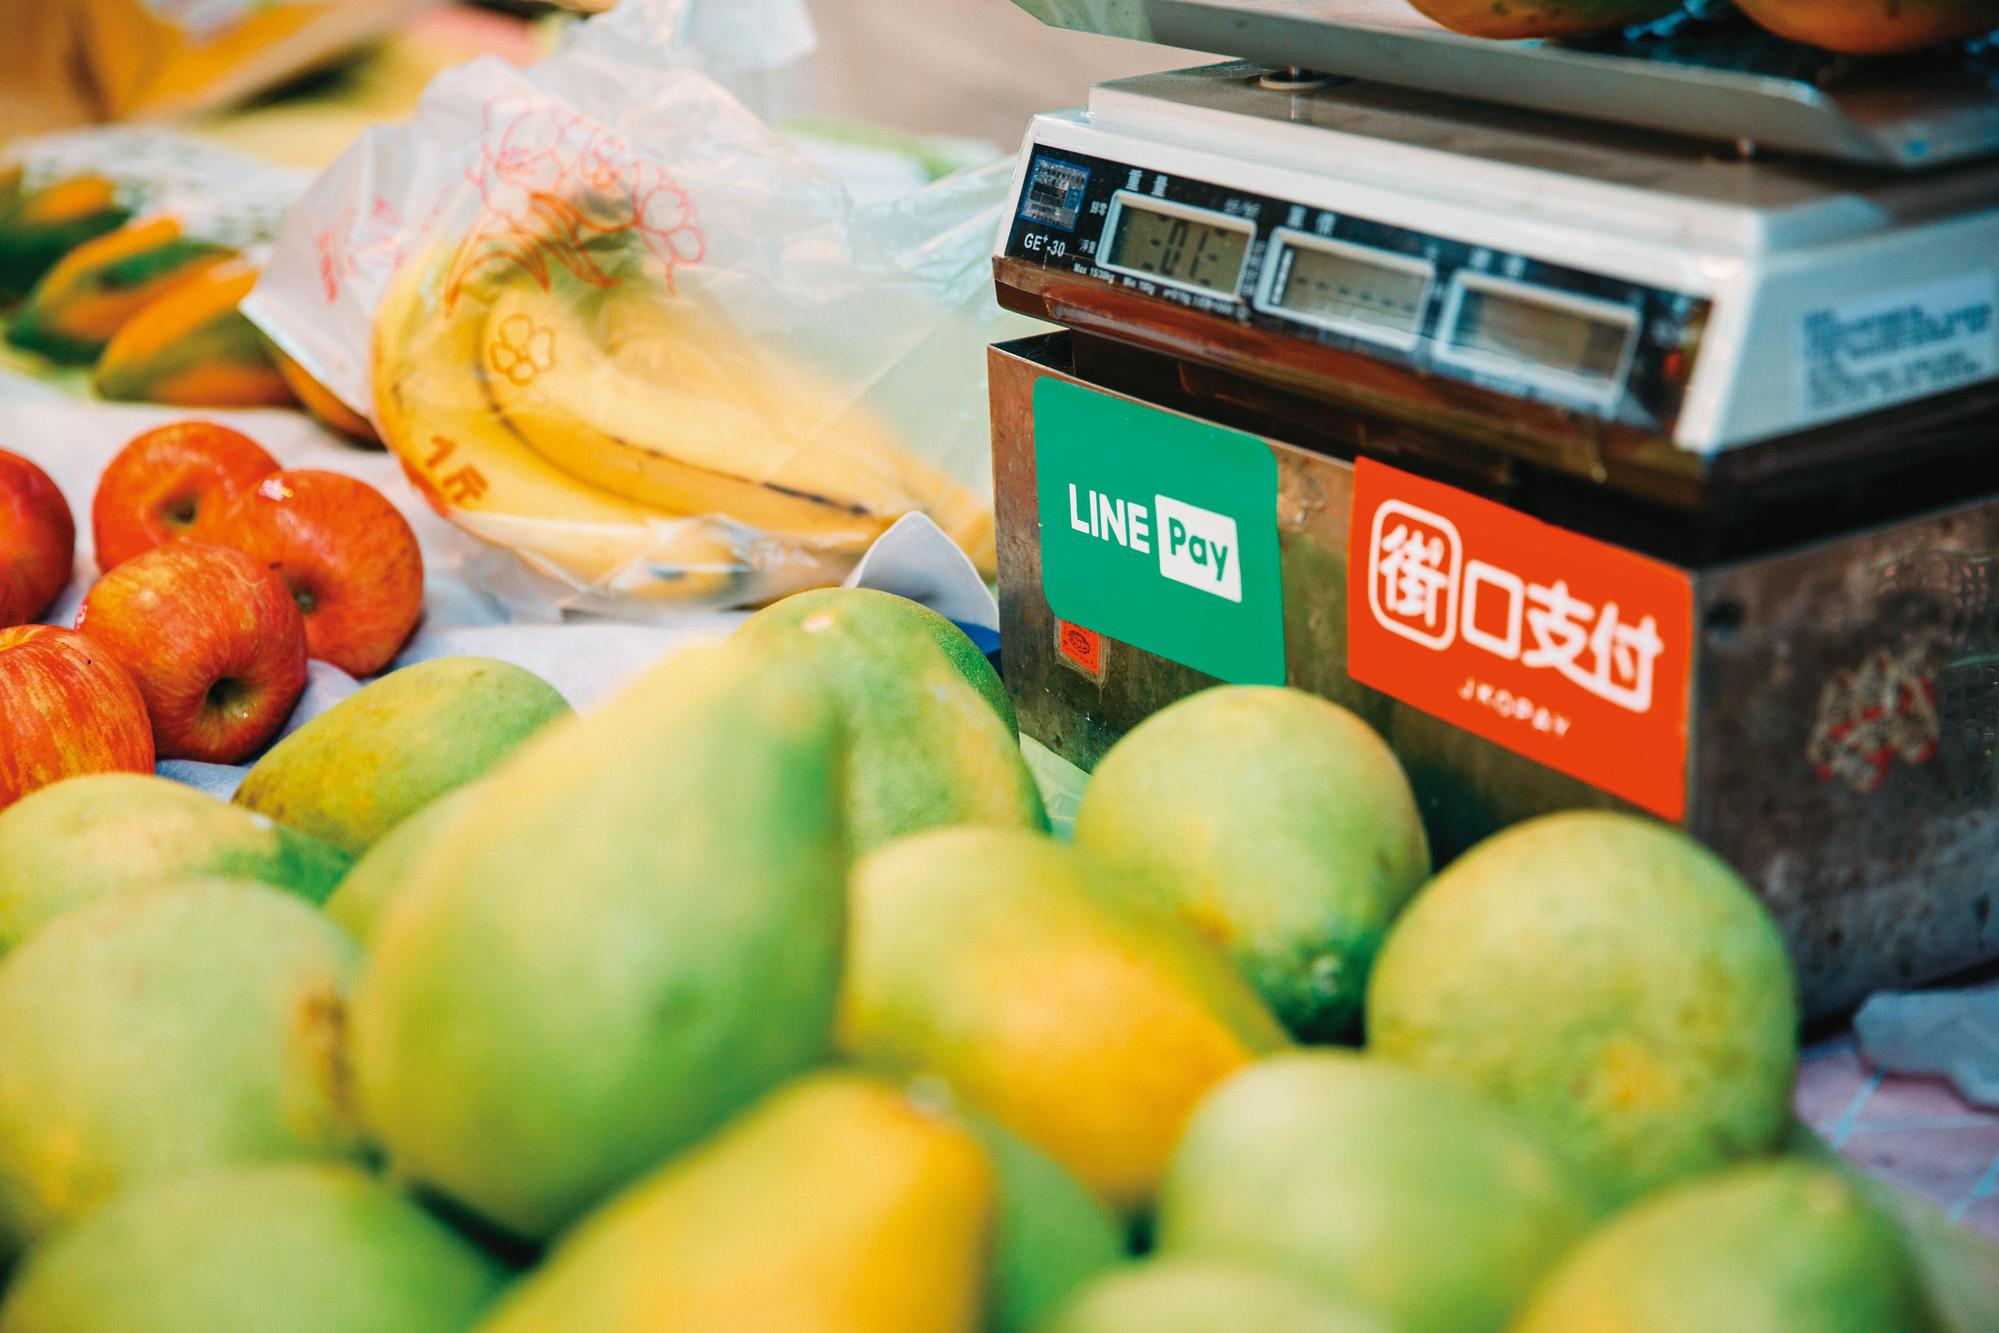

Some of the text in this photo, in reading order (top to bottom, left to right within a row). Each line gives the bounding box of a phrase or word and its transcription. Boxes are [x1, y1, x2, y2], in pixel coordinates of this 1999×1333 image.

[1068, 482, 1230, 582] LINE Pay
[1377, 522, 1665, 713] 街口支付
[1458, 677, 1571, 737] JKOPAY
